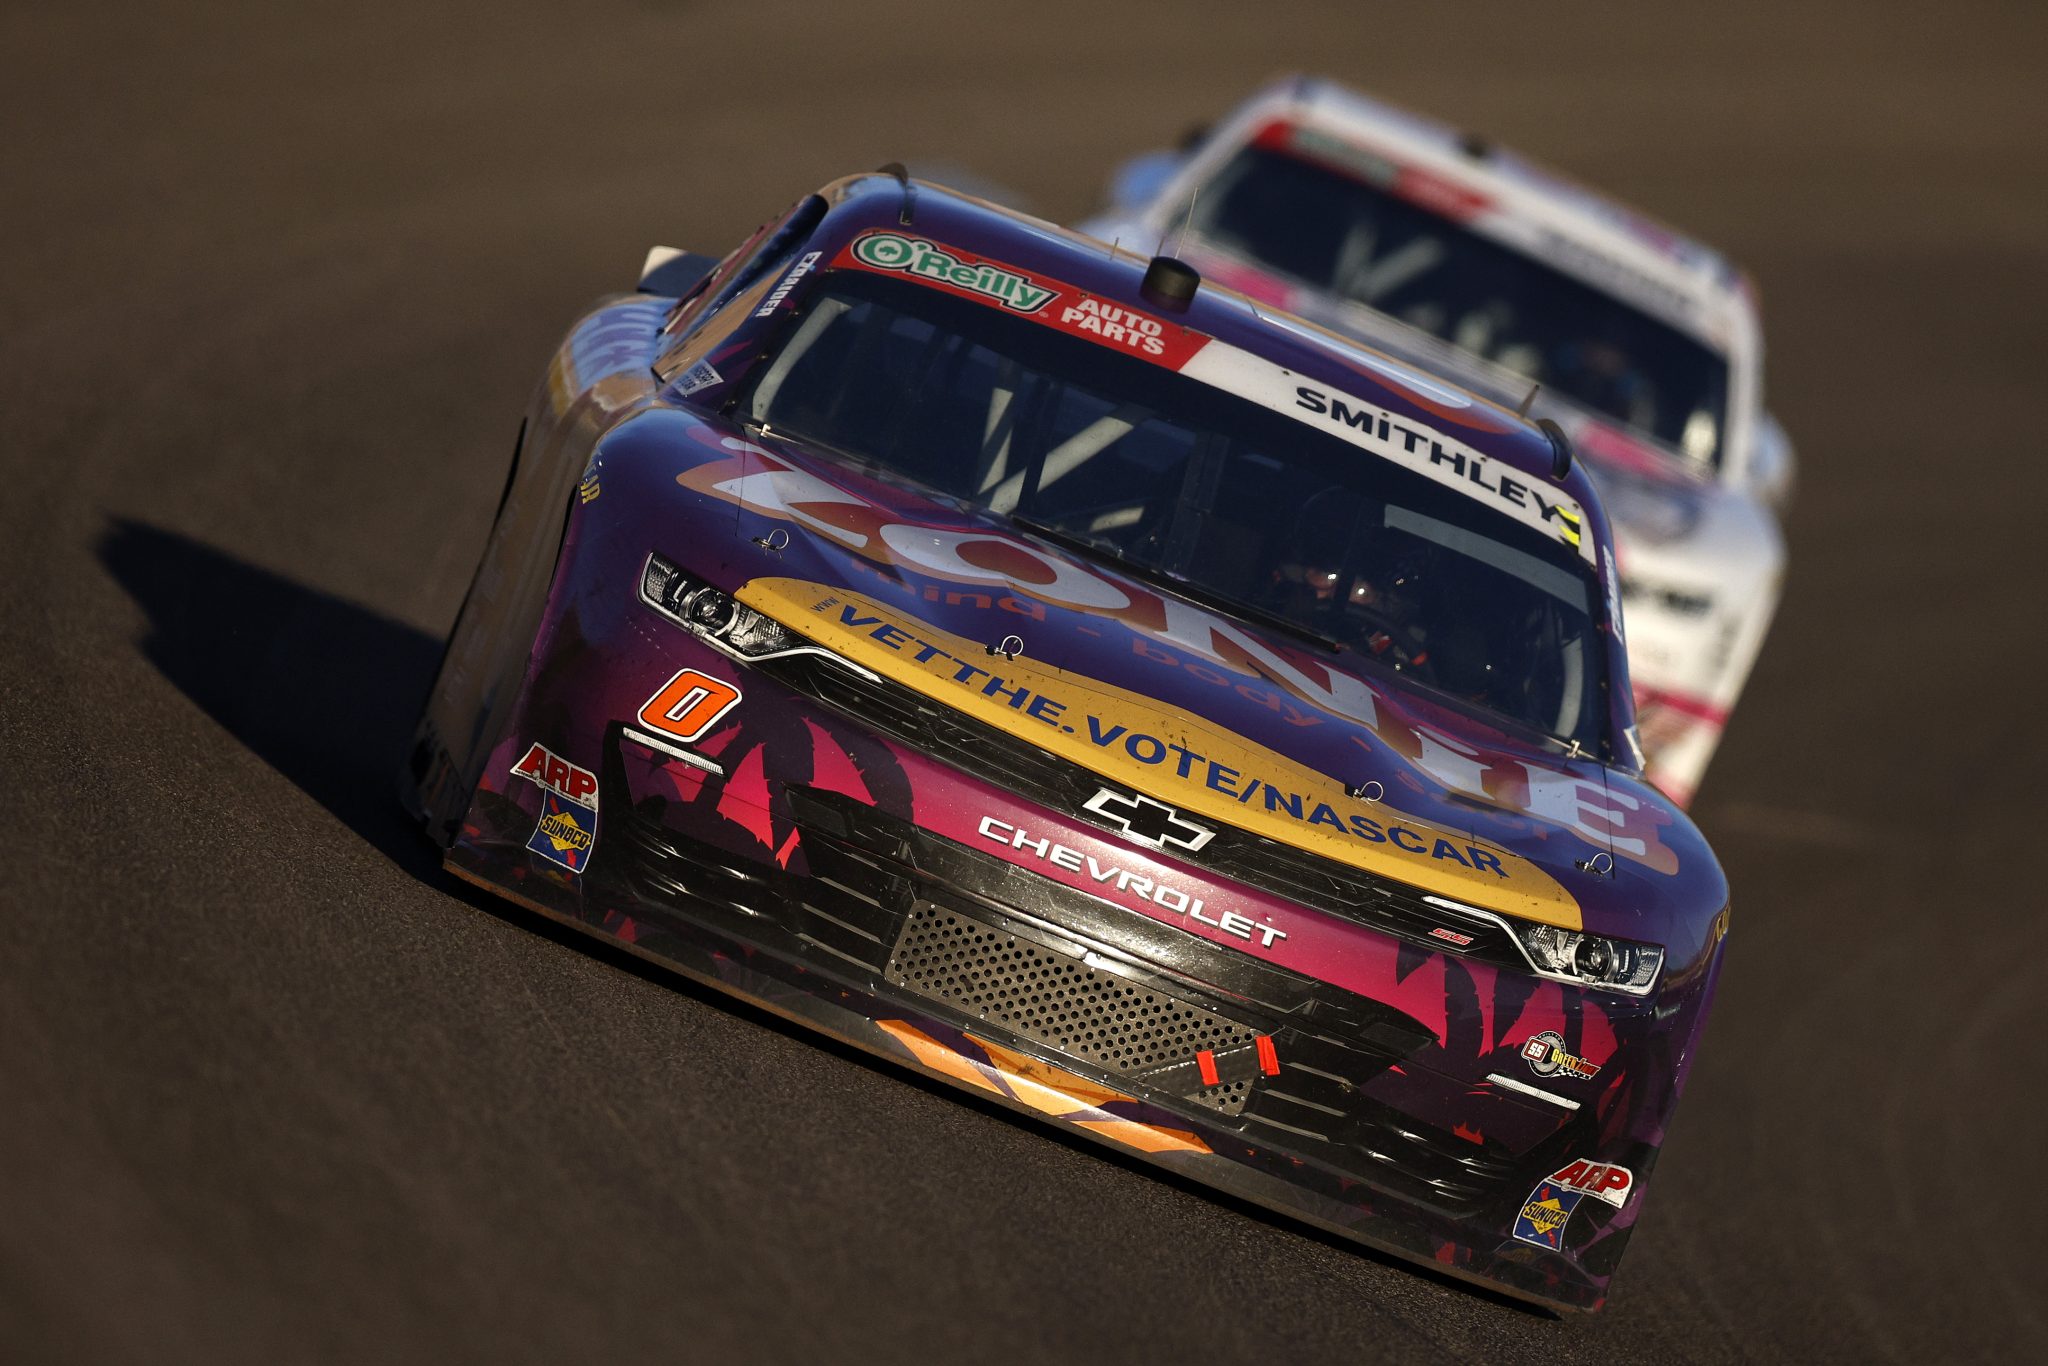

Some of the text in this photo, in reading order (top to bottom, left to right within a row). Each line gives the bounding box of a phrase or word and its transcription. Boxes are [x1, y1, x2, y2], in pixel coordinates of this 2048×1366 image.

[858, 235, 1057, 309] O'Reilly
[1061, 307, 1164, 355] PARTS
[1077, 299, 1162, 337] AUTO
[1296, 387, 1560, 522] SMITHLEY
[1133, 639, 1326, 727] body
[518, 745, 597, 800] ARP
[541, 816, 590, 849] SUNOCO
[978, 816, 1287, 947] CHEVROLET
[1551, 1160, 1630, 1194] ARP
[1524, 1203, 1568, 1227] SUNOCO
